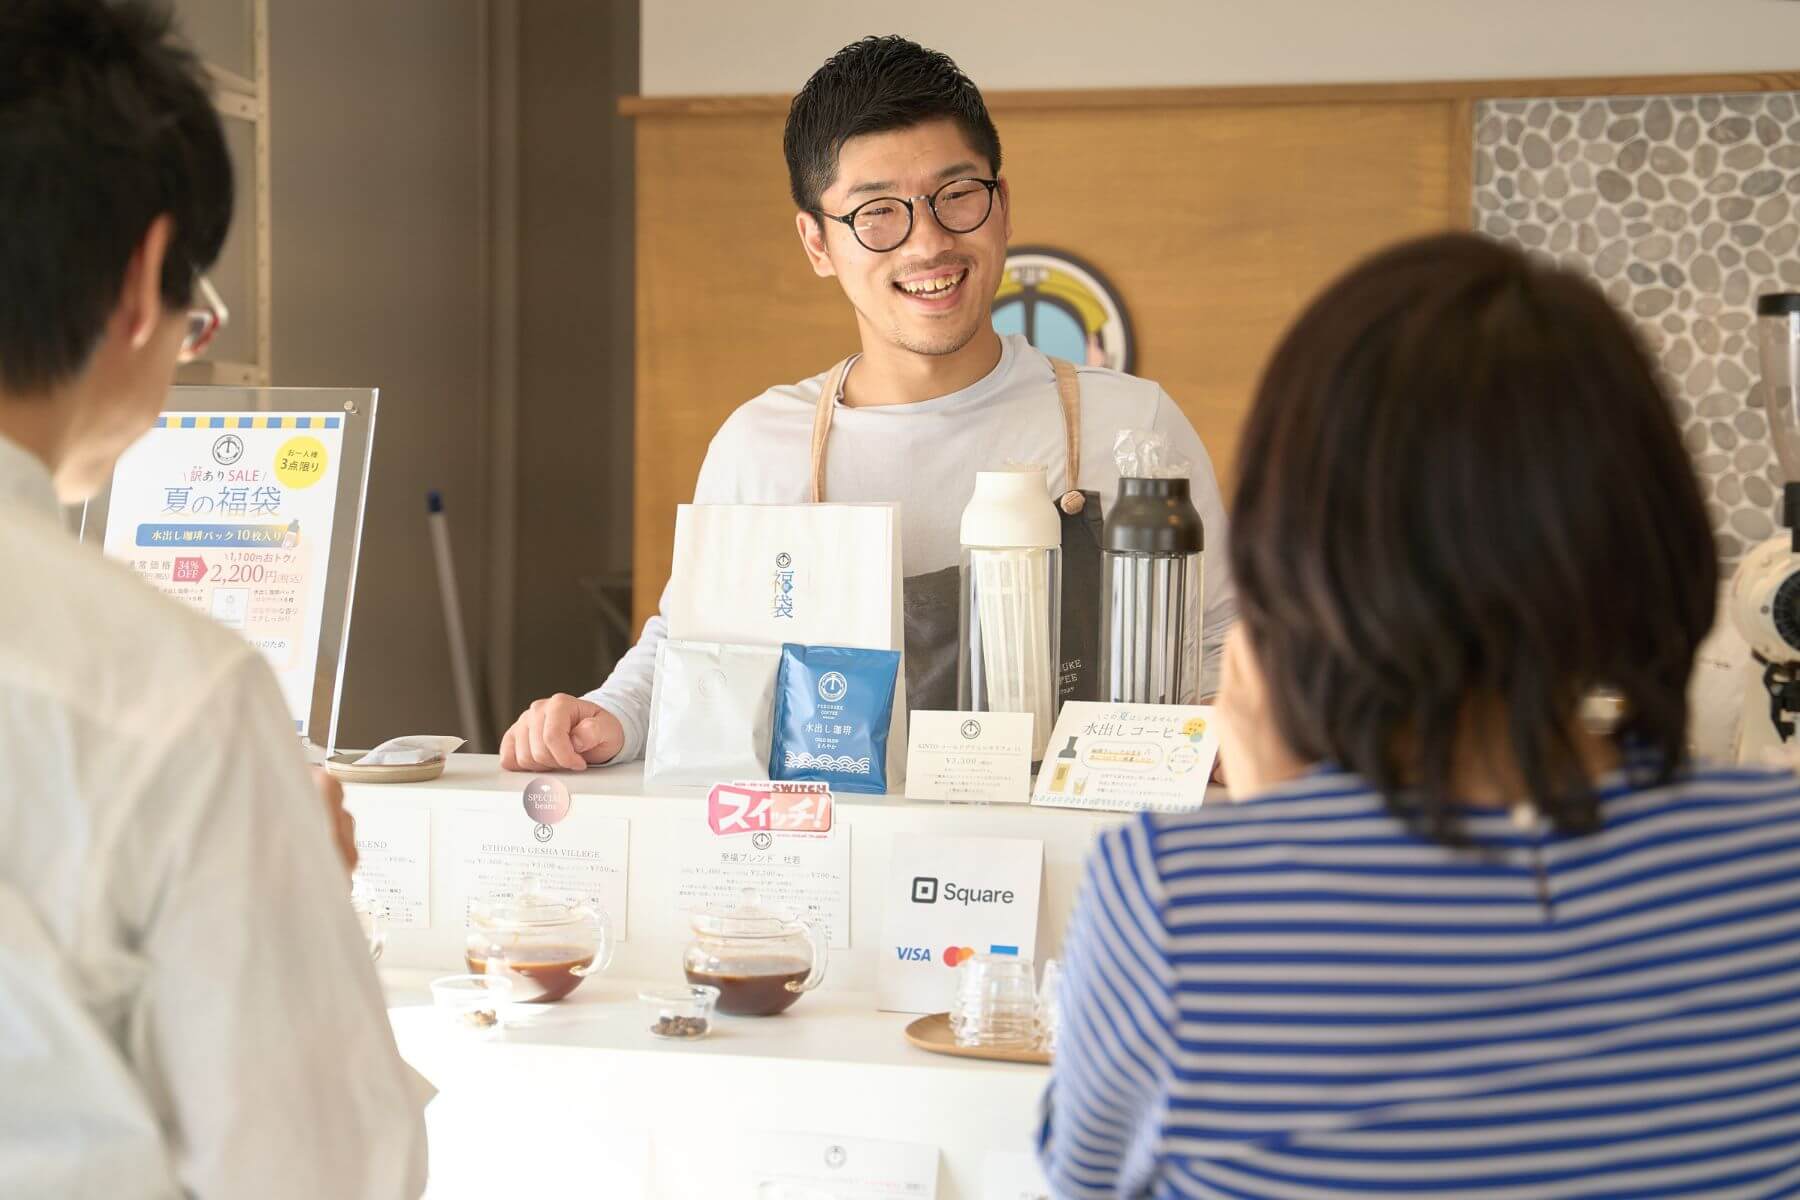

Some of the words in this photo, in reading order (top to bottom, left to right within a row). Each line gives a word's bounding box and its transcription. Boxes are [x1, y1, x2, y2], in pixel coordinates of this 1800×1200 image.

[280, 458, 320, 473] 3点限り
[190, 470, 225, 482] 訳あり
[227, 470, 260, 482] SALE
[161, 486, 281, 513] 夏の福袋
[177, 569, 200, 578] OFF
[774, 569, 794, 618] 福袋
[806, 722, 852, 735] 水出し珈琲
[1083, 720, 1191, 739] 水出しコーヒー
[772, 783, 827, 793] SWITCH
[718, 790, 828, 831] スイッチ!
[943, 881, 1015, 906] Square
[896, 946, 932, 962] VISA
